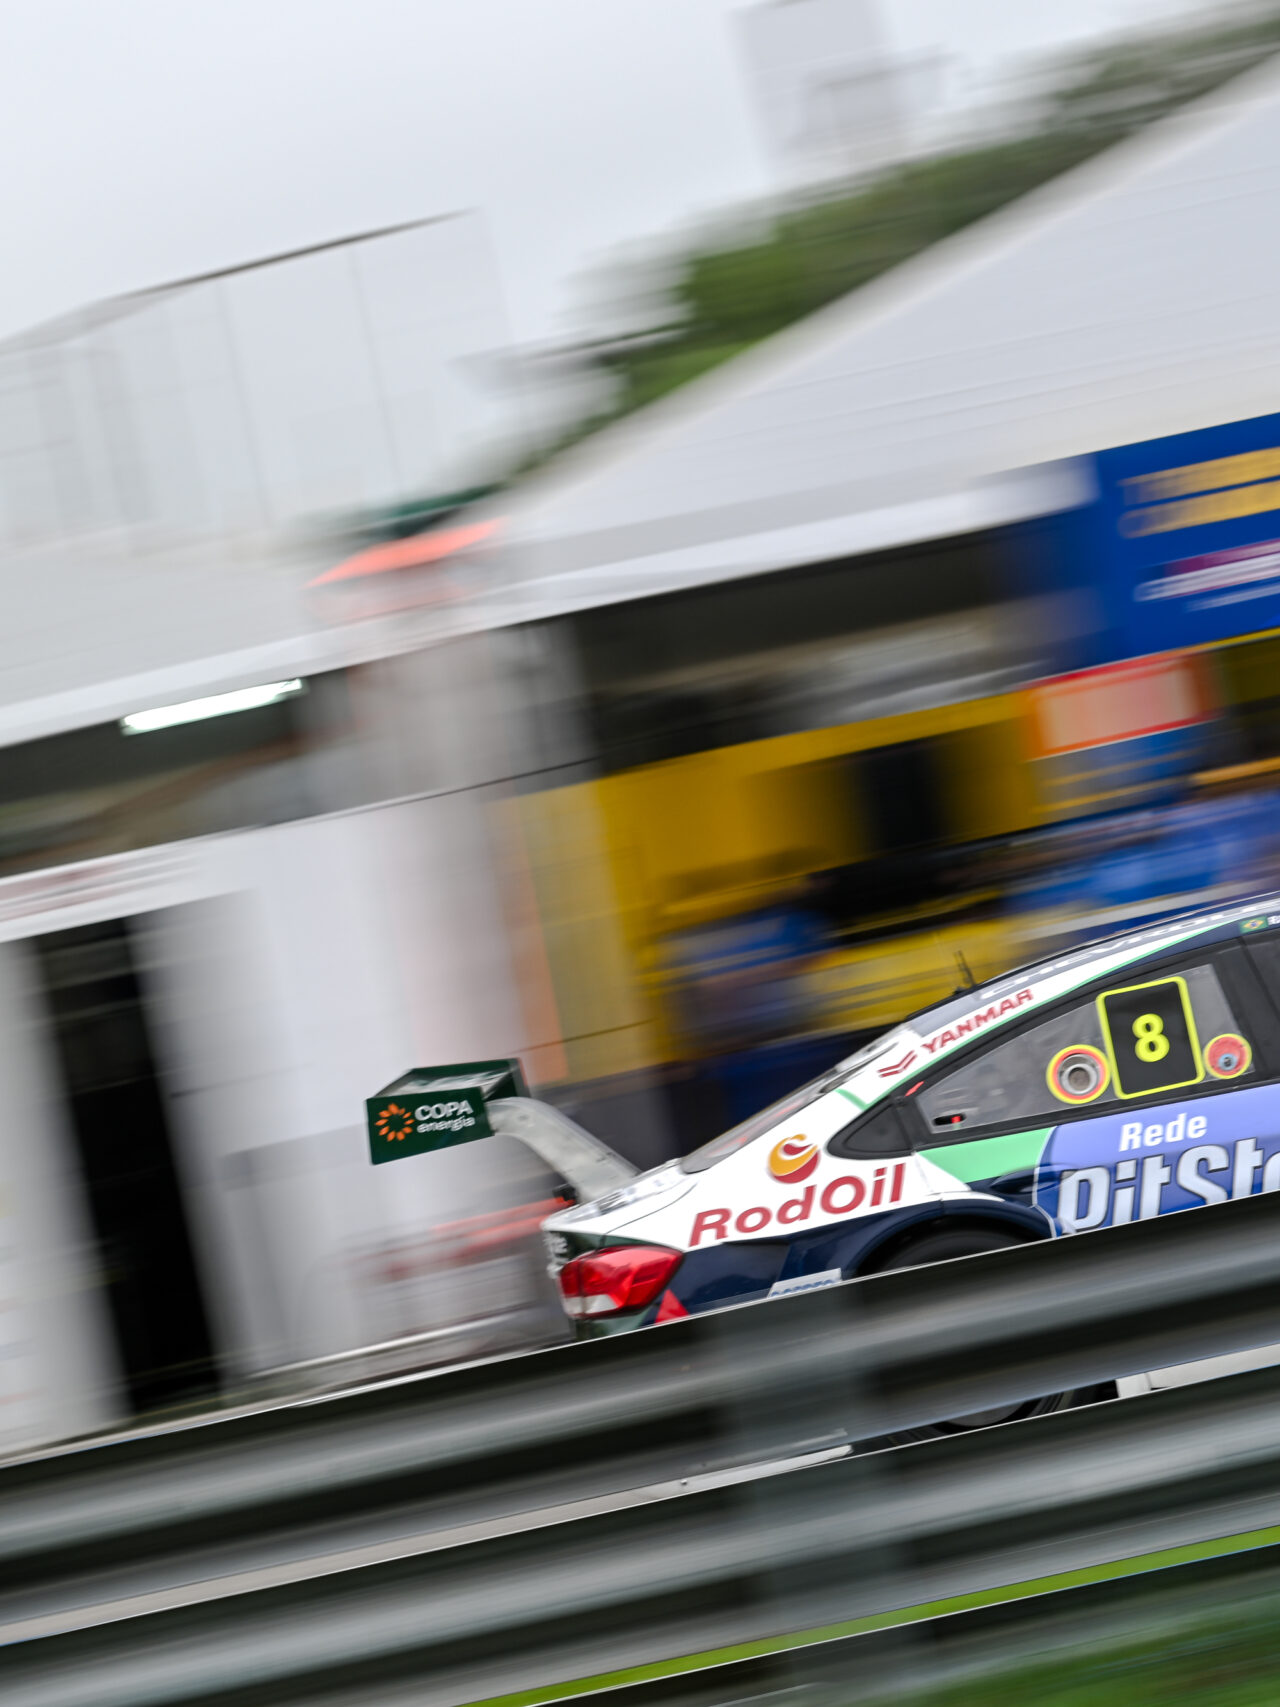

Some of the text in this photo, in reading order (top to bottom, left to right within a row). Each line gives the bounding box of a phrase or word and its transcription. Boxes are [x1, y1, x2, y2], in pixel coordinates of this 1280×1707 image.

[922, 988, 1034, 1054] YANMAR
[1132, 1013, 1170, 1062] 8
[415, 1100, 474, 1121] COPA
[1119, 1113, 1208, 1152] Rede
[689, 1163, 906, 1248] RodOil
